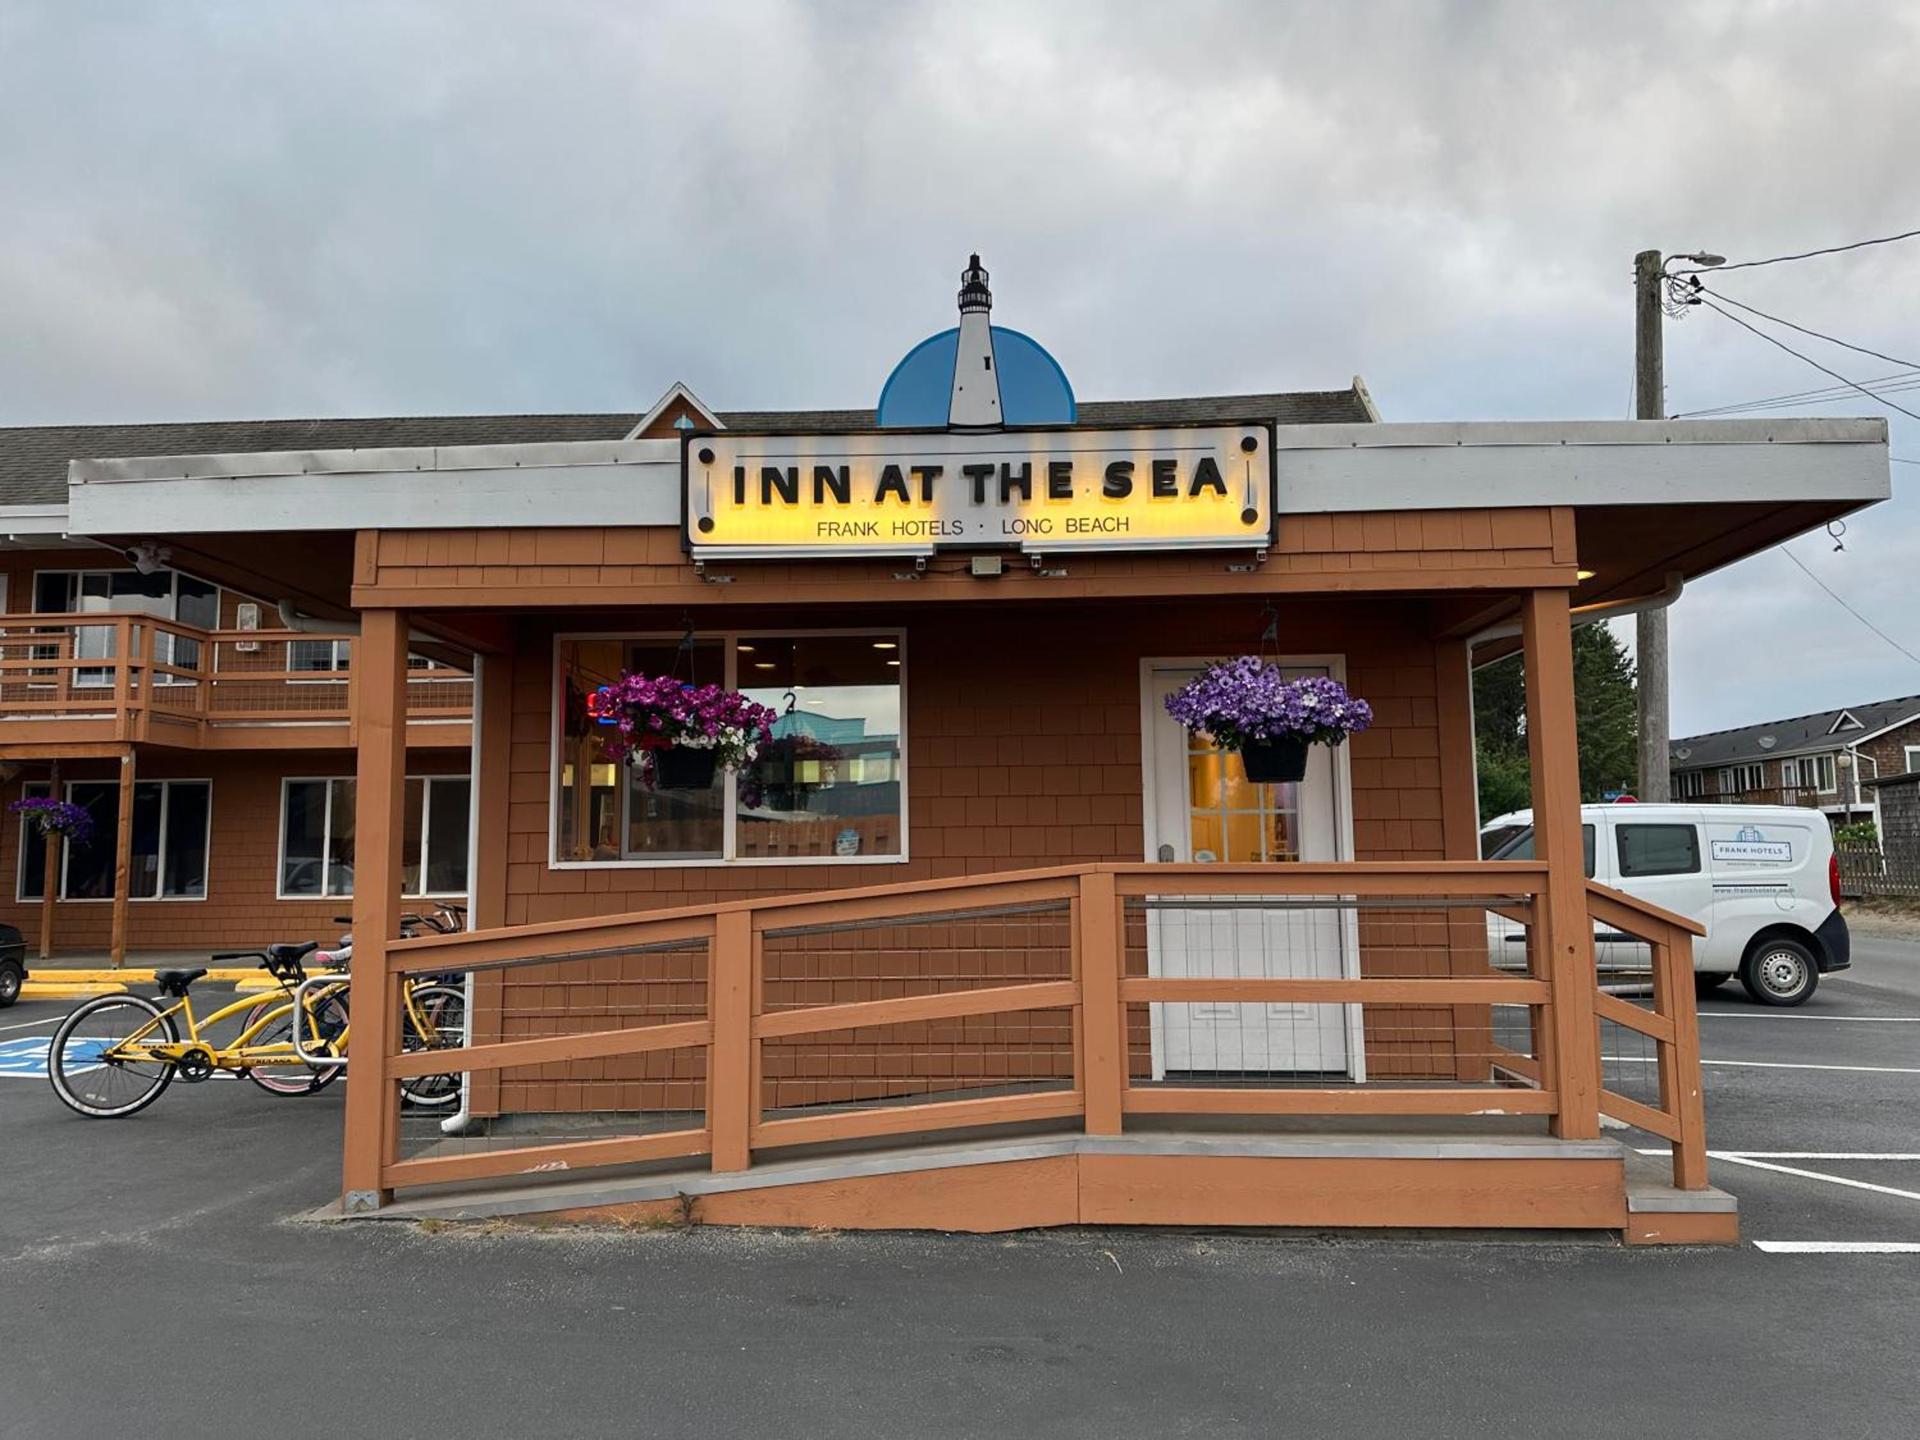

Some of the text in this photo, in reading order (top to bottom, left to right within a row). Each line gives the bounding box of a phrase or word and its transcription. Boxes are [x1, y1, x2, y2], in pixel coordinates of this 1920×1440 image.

[734, 457, 1228, 505] INN AT THE SEA
[816, 516, 1129, 537] FRANK HOTELS LONG BEACH
[1750, 847, 1784, 855] HOTELS
